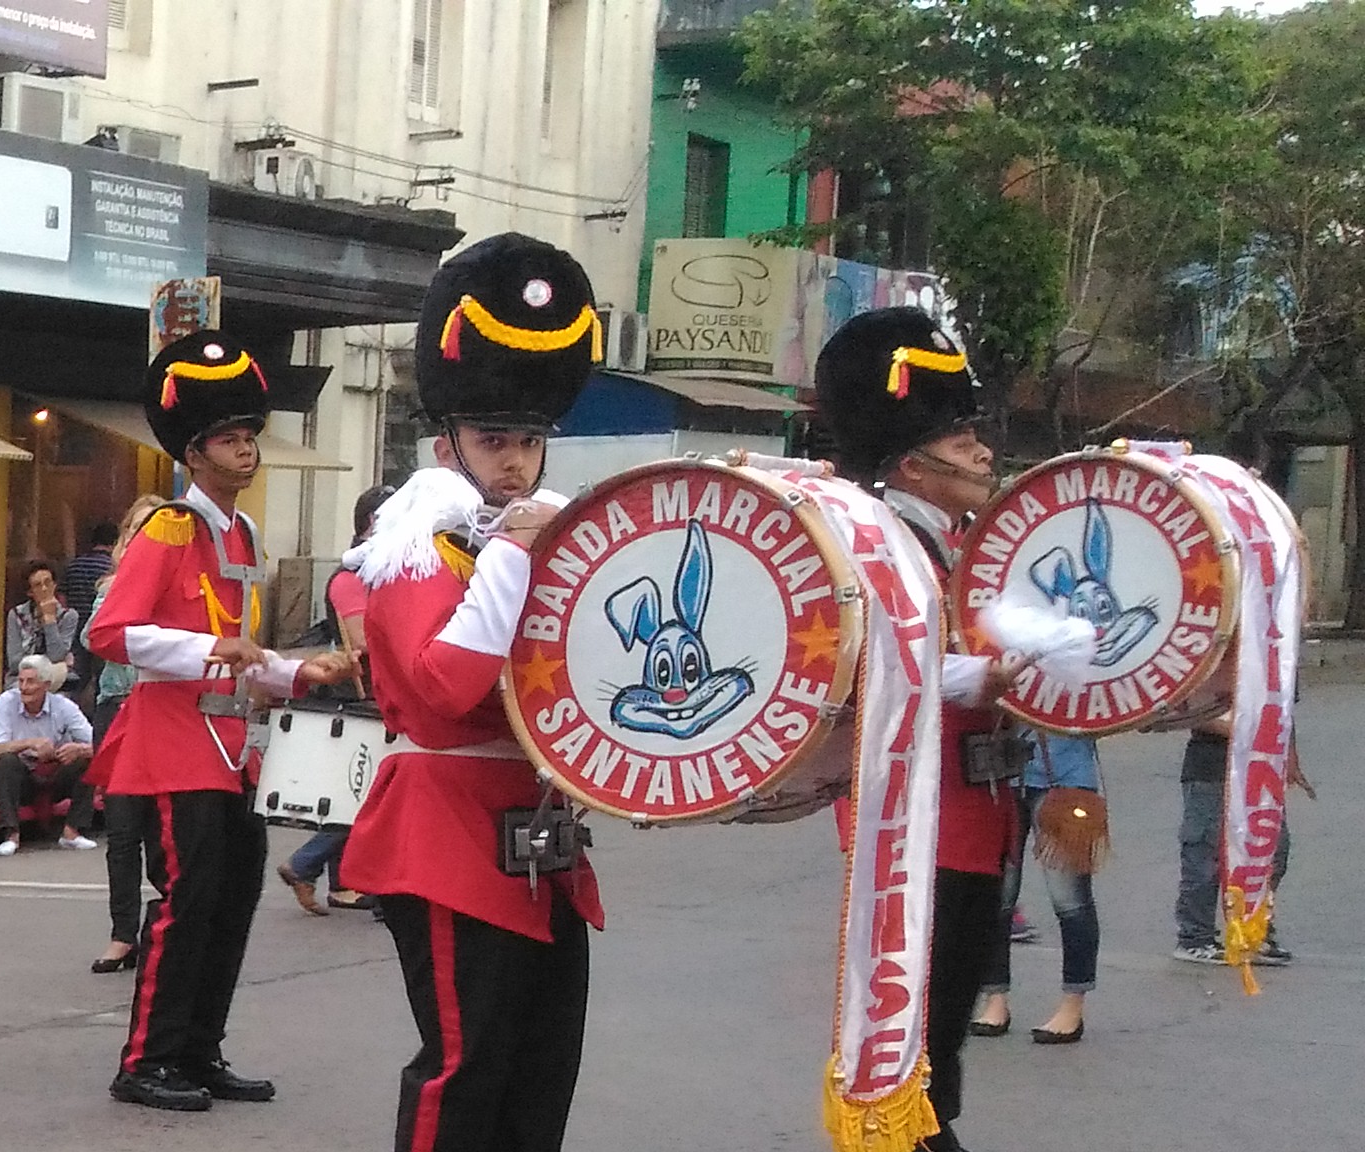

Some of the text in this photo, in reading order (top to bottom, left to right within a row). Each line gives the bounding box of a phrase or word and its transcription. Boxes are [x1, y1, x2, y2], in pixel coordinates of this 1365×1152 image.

[522, 479, 832, 642] BANDA MARCIAL
[967, 466, 1211, 609] BANDA MARCIAL
[352, 742, 369, 803] ADAH
[536, 671, 829, 806] SANTANENSE
